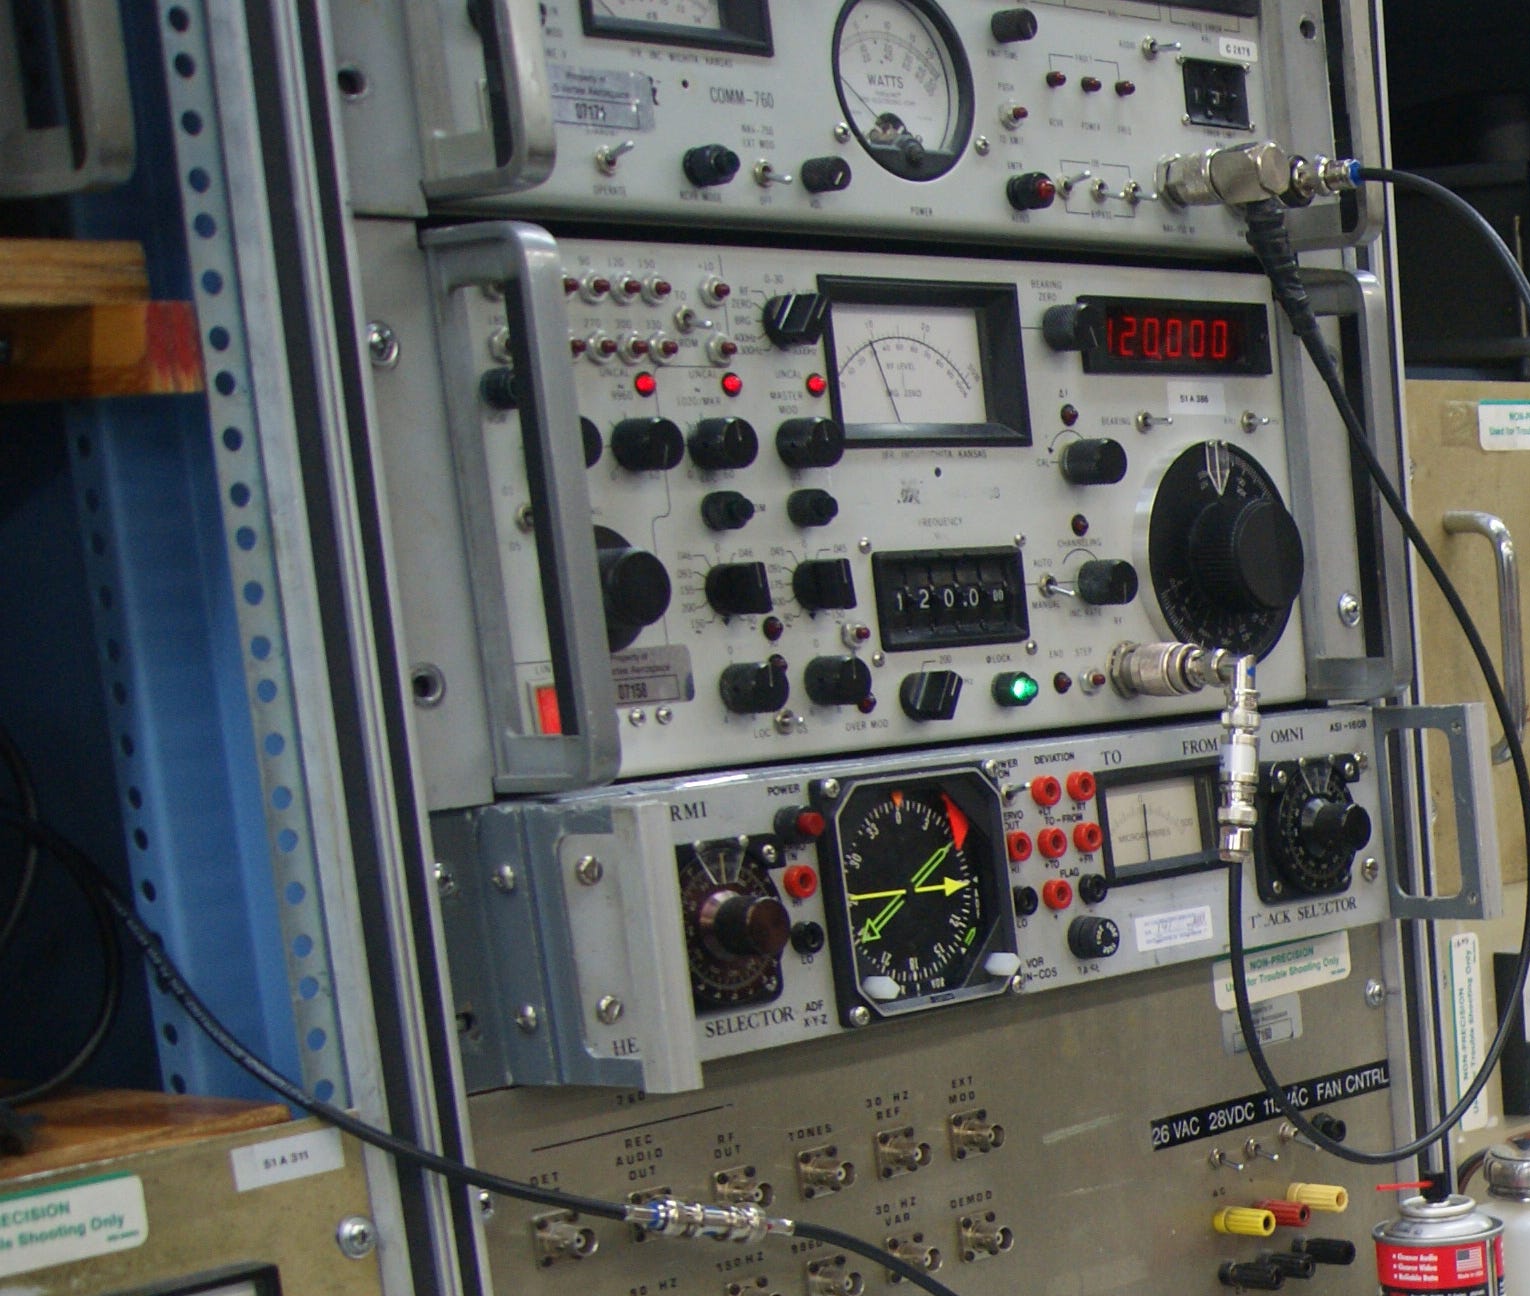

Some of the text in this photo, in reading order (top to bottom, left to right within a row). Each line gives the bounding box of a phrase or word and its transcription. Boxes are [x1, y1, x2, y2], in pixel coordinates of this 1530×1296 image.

[867, 73, 905, 90] WATTS
[708, 86, 774, 109] COMM-760
[910, 205, 933, 217] POWER
[1031, 280, 1062, 290] BEARING
[1038, 292, 1057, 302] ZERO
[1102, 417, 1131, 426] BEARING
[918, 517, 963, 527] FREQUENCY
[1033, 560, 1052, 569] AUTO
[1270, 726, 1304, 744] OMNI
[1182, 737, 1218, 755] FROM
[1034, 752, 1075, 765] DEVIATION
[1101, 750, 1122, 766] TO
[768, 784, 800, 797] POWER
[669, 800, 707, 822] RMI
[1003, 811, 1023, 822] ERVO
[1059, 867, 1080, 878] FLAG
[1026, 957, 1045, 969] VOR
[1249, 945, 1315, 971] NON-PRECISION
[1022, 967, 1058, 982] IN-COS
[1259, 970, 1287, 984] Trouble
[1289, 960, 1321, 977] Shooting
[1322, 954, 1340, 969] Only
[805, 1001, 824, 1013] ADF
[705, 1005, 795, 1039] SELECTOR
[1457, 986, 1469, 1082] NON-PRECISION
[951, 1075, 975, 1091] EXT
[866, 1090, 910, 1109] 30 HZ
[948, 1091, 976, 1104] MOD
[877, 1106, 901, 1121] REF
[1152, 1124, 1171, 1146] 26
[1173, 1117, 1201, 1141] VAC
[1209, 1101, 1255, 1129] 28VDC
[1316, 1079, 1342, 1101] FAN
[1345, 1067, 1389, 1093] CNTRL
[717, 1132, 736, 1145] RF
[788, 1123, 833, 1142] TONES
[624, 1133, 653, 1149] REC
[615, 1148, 664, 1167] AUDIO
[714, 1144, 742, 1159] OUT
[628, 1165, 657, 1181] OUT
[875, 1197, 918, 1216] 30 HZ
[950, 1190, 993, 1209] DEMOD
[885, 1212, 911, 1226] VAR
[17, 1222, 87, 1246] Shooting
[89, 1213, 125, 1231] Only
[745, 1251, 765, 1265] HZ
[658, 1277, 679, 1290] HZ
